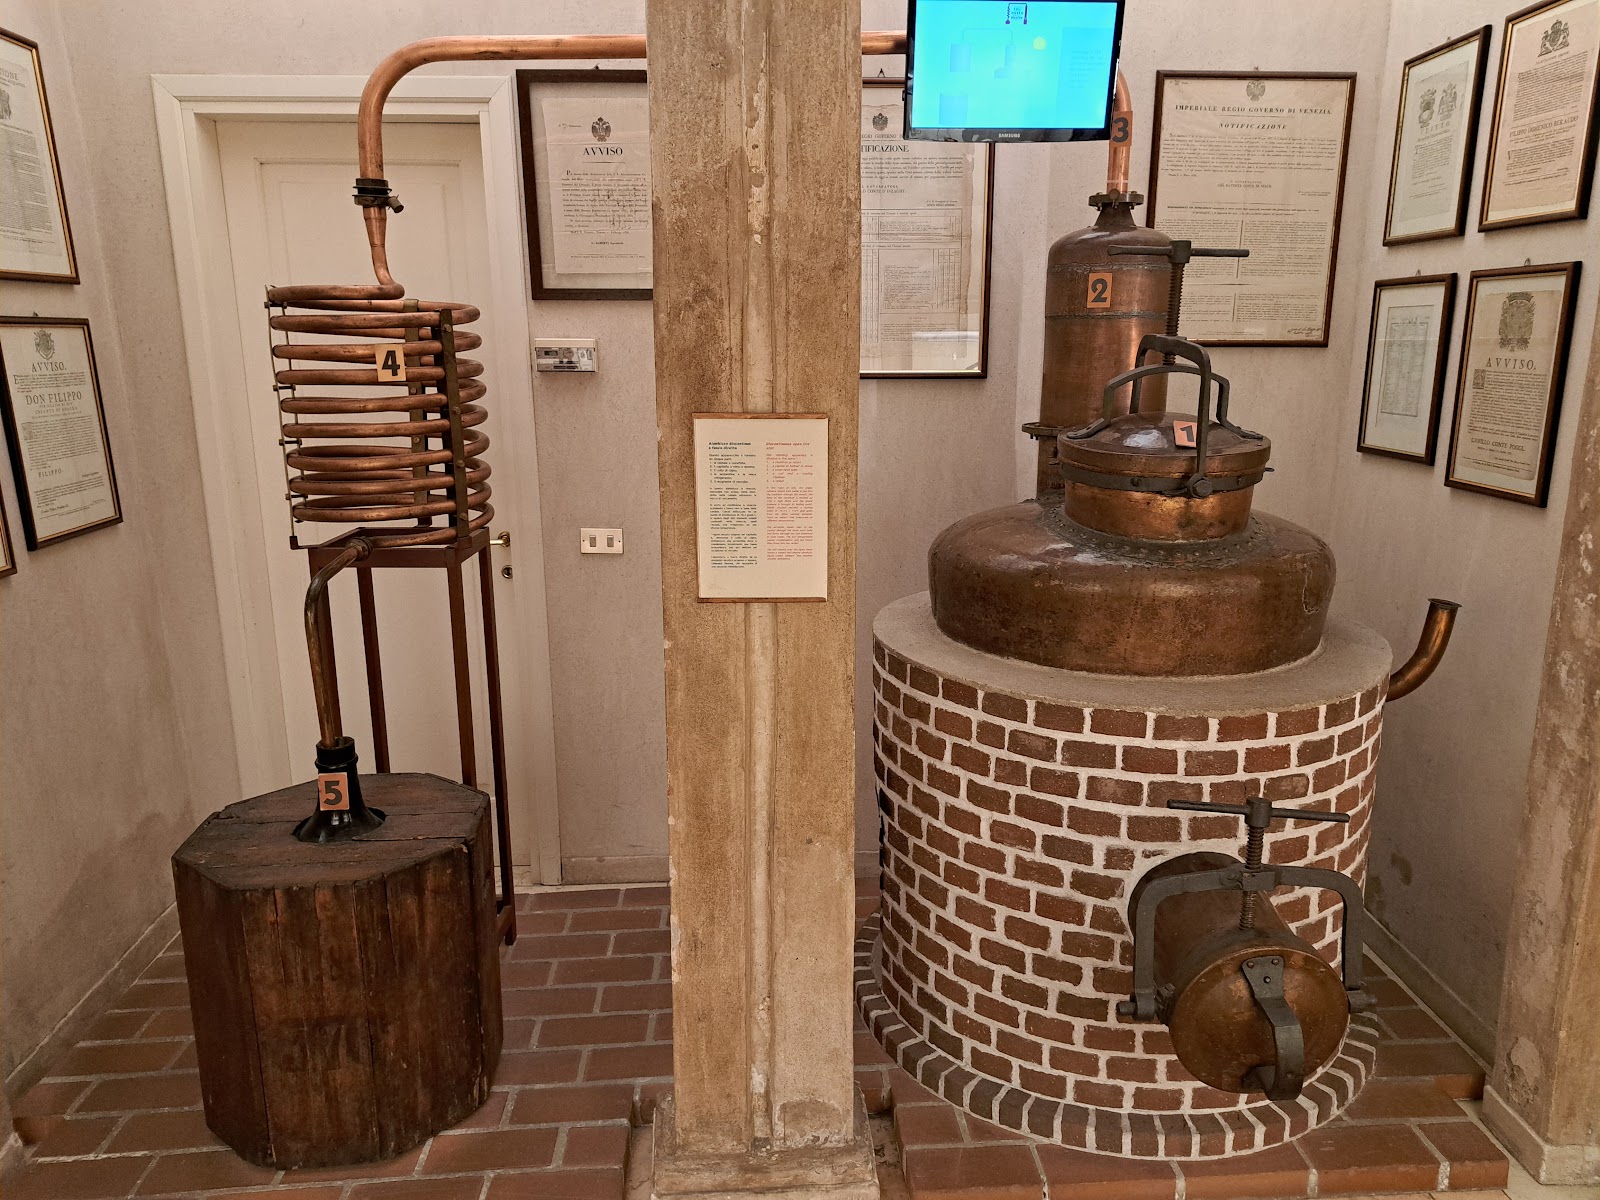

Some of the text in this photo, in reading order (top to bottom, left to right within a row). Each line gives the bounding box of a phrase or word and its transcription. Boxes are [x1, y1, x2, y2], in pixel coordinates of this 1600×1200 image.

[1175, 104, 1218, 112] IMPERIALE
[1112, 116, 1129, 143] 3
[1219, 122, 1288, 130] NOTIFICAZIONE
[583, 147, 623, 156] AVVISO
[1091, 278, 1108, 303] 2
[32, 361, 67, 373] AVVISO.
[382, 350, 401, 377] 4
[1485, 357, 1537, 371] AVVISO.
[26, 390, 82, 406] DON FILIPPO
[1179, 425, 1195, 442] 1
[324, 780, 343, 806] 5
